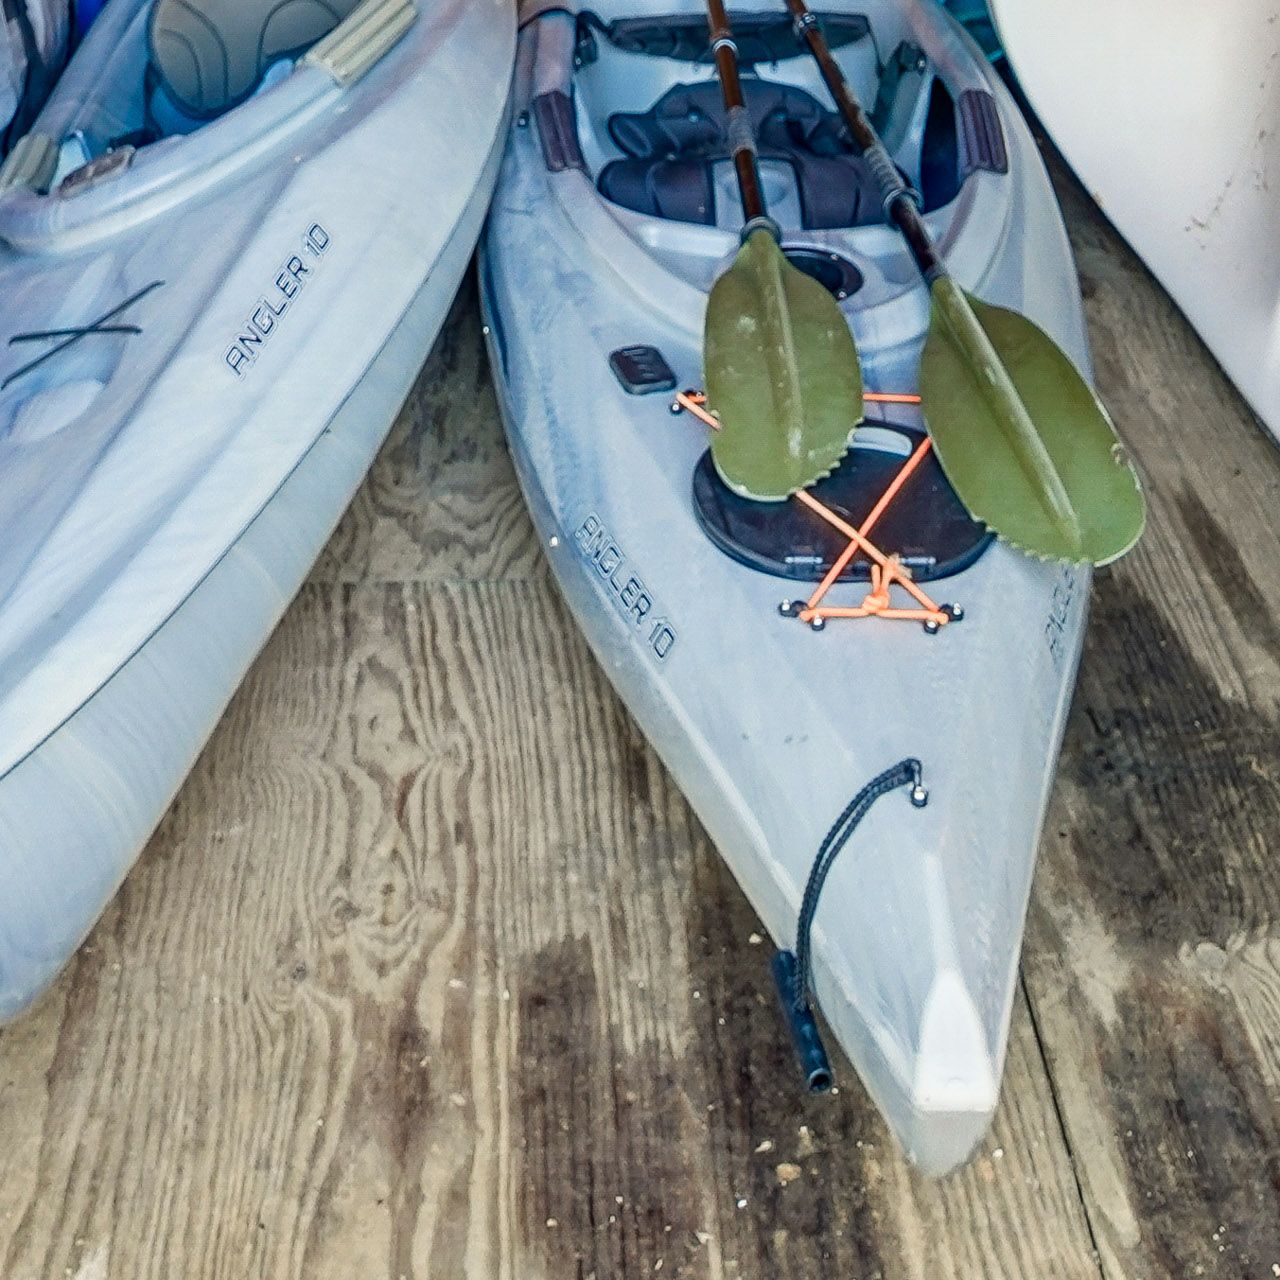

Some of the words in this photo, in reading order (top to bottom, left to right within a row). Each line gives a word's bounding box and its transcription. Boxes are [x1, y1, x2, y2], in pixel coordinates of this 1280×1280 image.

[224, 253, 310, 377] ANGLER
[304, 222, 331, 257] 10
[575, 513, 653, 626] ANGLER
[648, 618, 677, 661] 10
